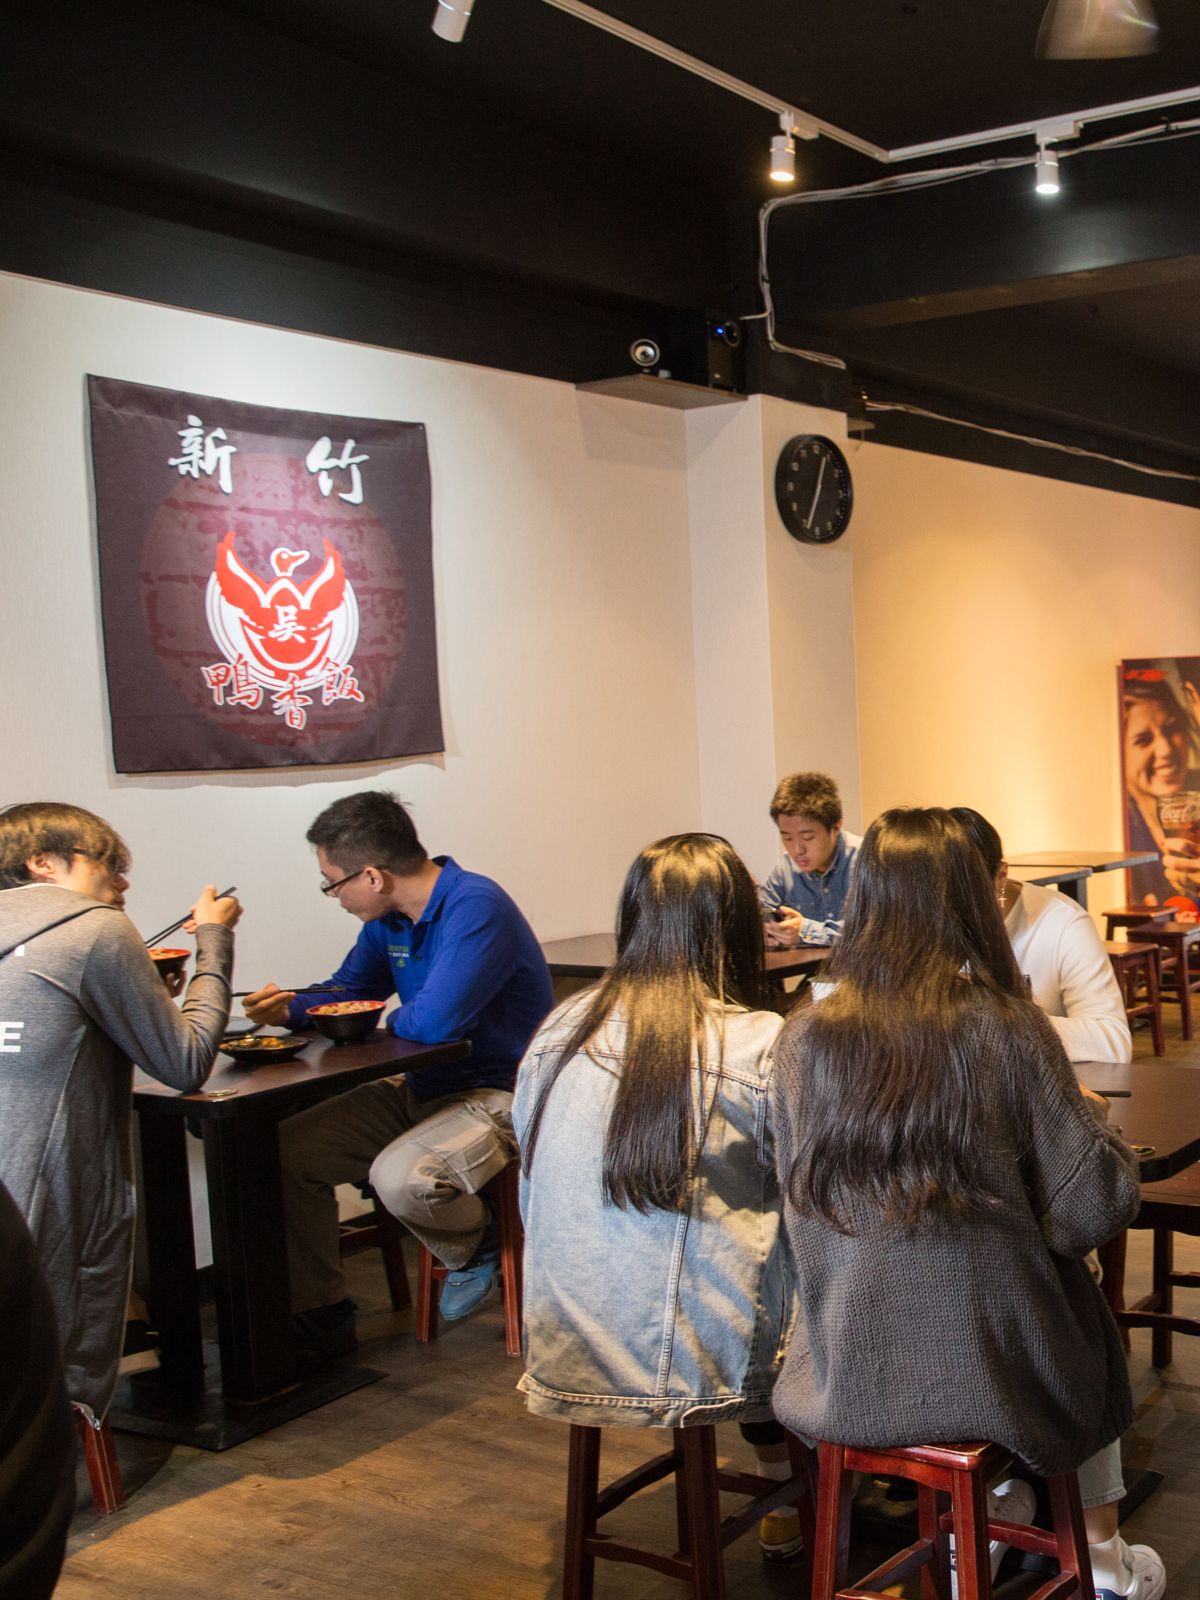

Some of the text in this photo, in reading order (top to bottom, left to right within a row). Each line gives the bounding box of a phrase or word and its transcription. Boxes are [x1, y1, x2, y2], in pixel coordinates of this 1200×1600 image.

[168, 414, 369, 504] 新竹
[200, 654, 364, 730] 鴨香飯
